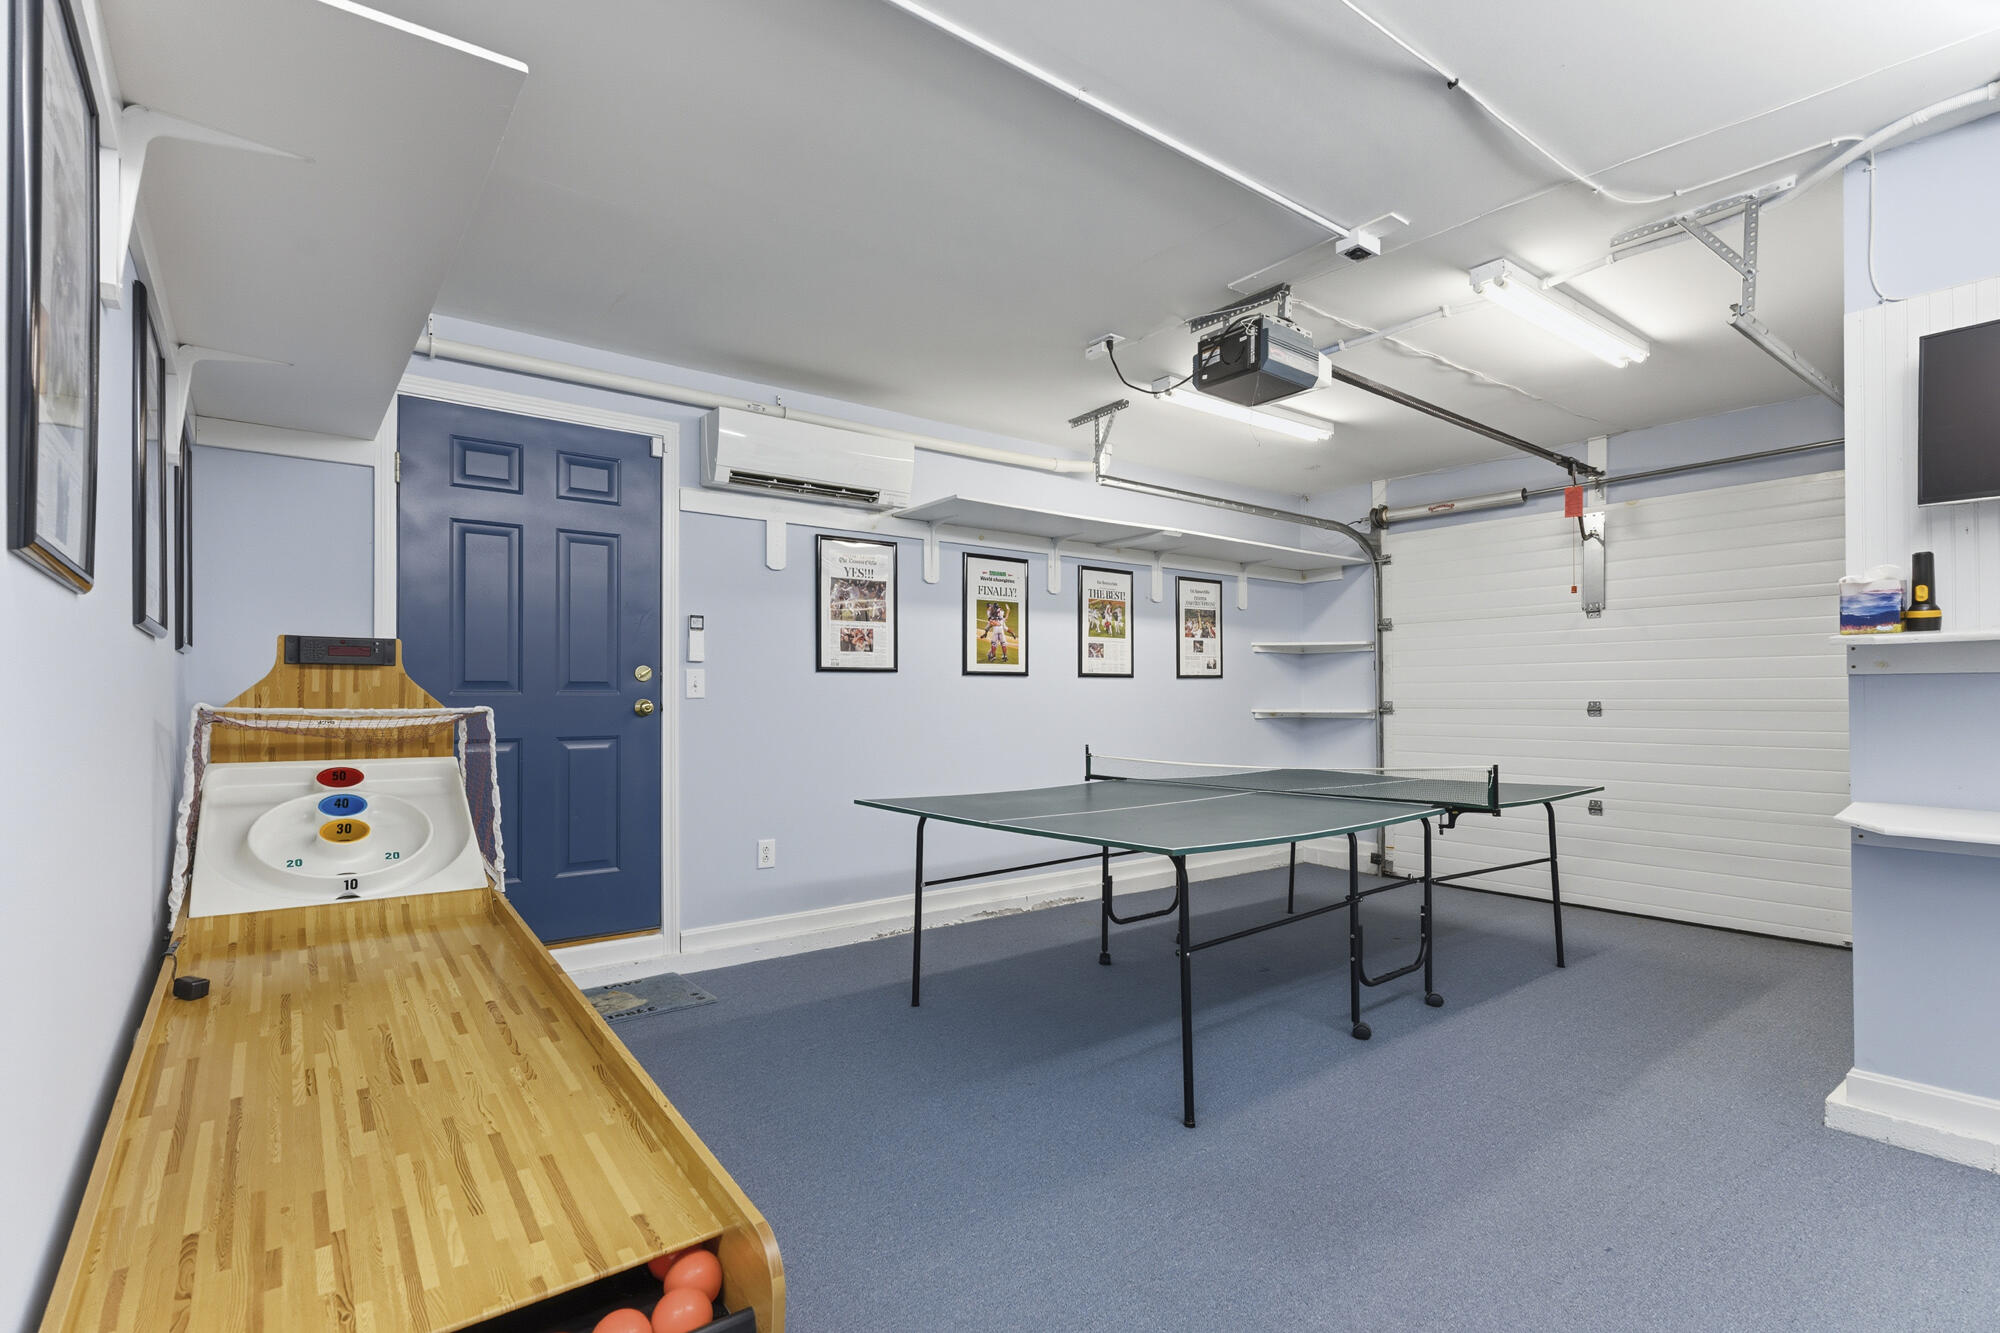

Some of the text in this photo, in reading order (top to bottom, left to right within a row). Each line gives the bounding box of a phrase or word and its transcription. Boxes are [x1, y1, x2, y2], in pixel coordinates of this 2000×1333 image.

[843, 566, 874, 579] YES!!!
[978, 585, 1017, 597] FINALLY!
[1088, 588, 1126, 601] THE BEST!
[332, 771, 346, 782] 50
[334, 798, 349, 809] 40
[336, 823, 352, 834] 30
[385, 851, 400, 860] 20
[286, 858, 303, 868] 20
[343, 878, 358, 890] 10
